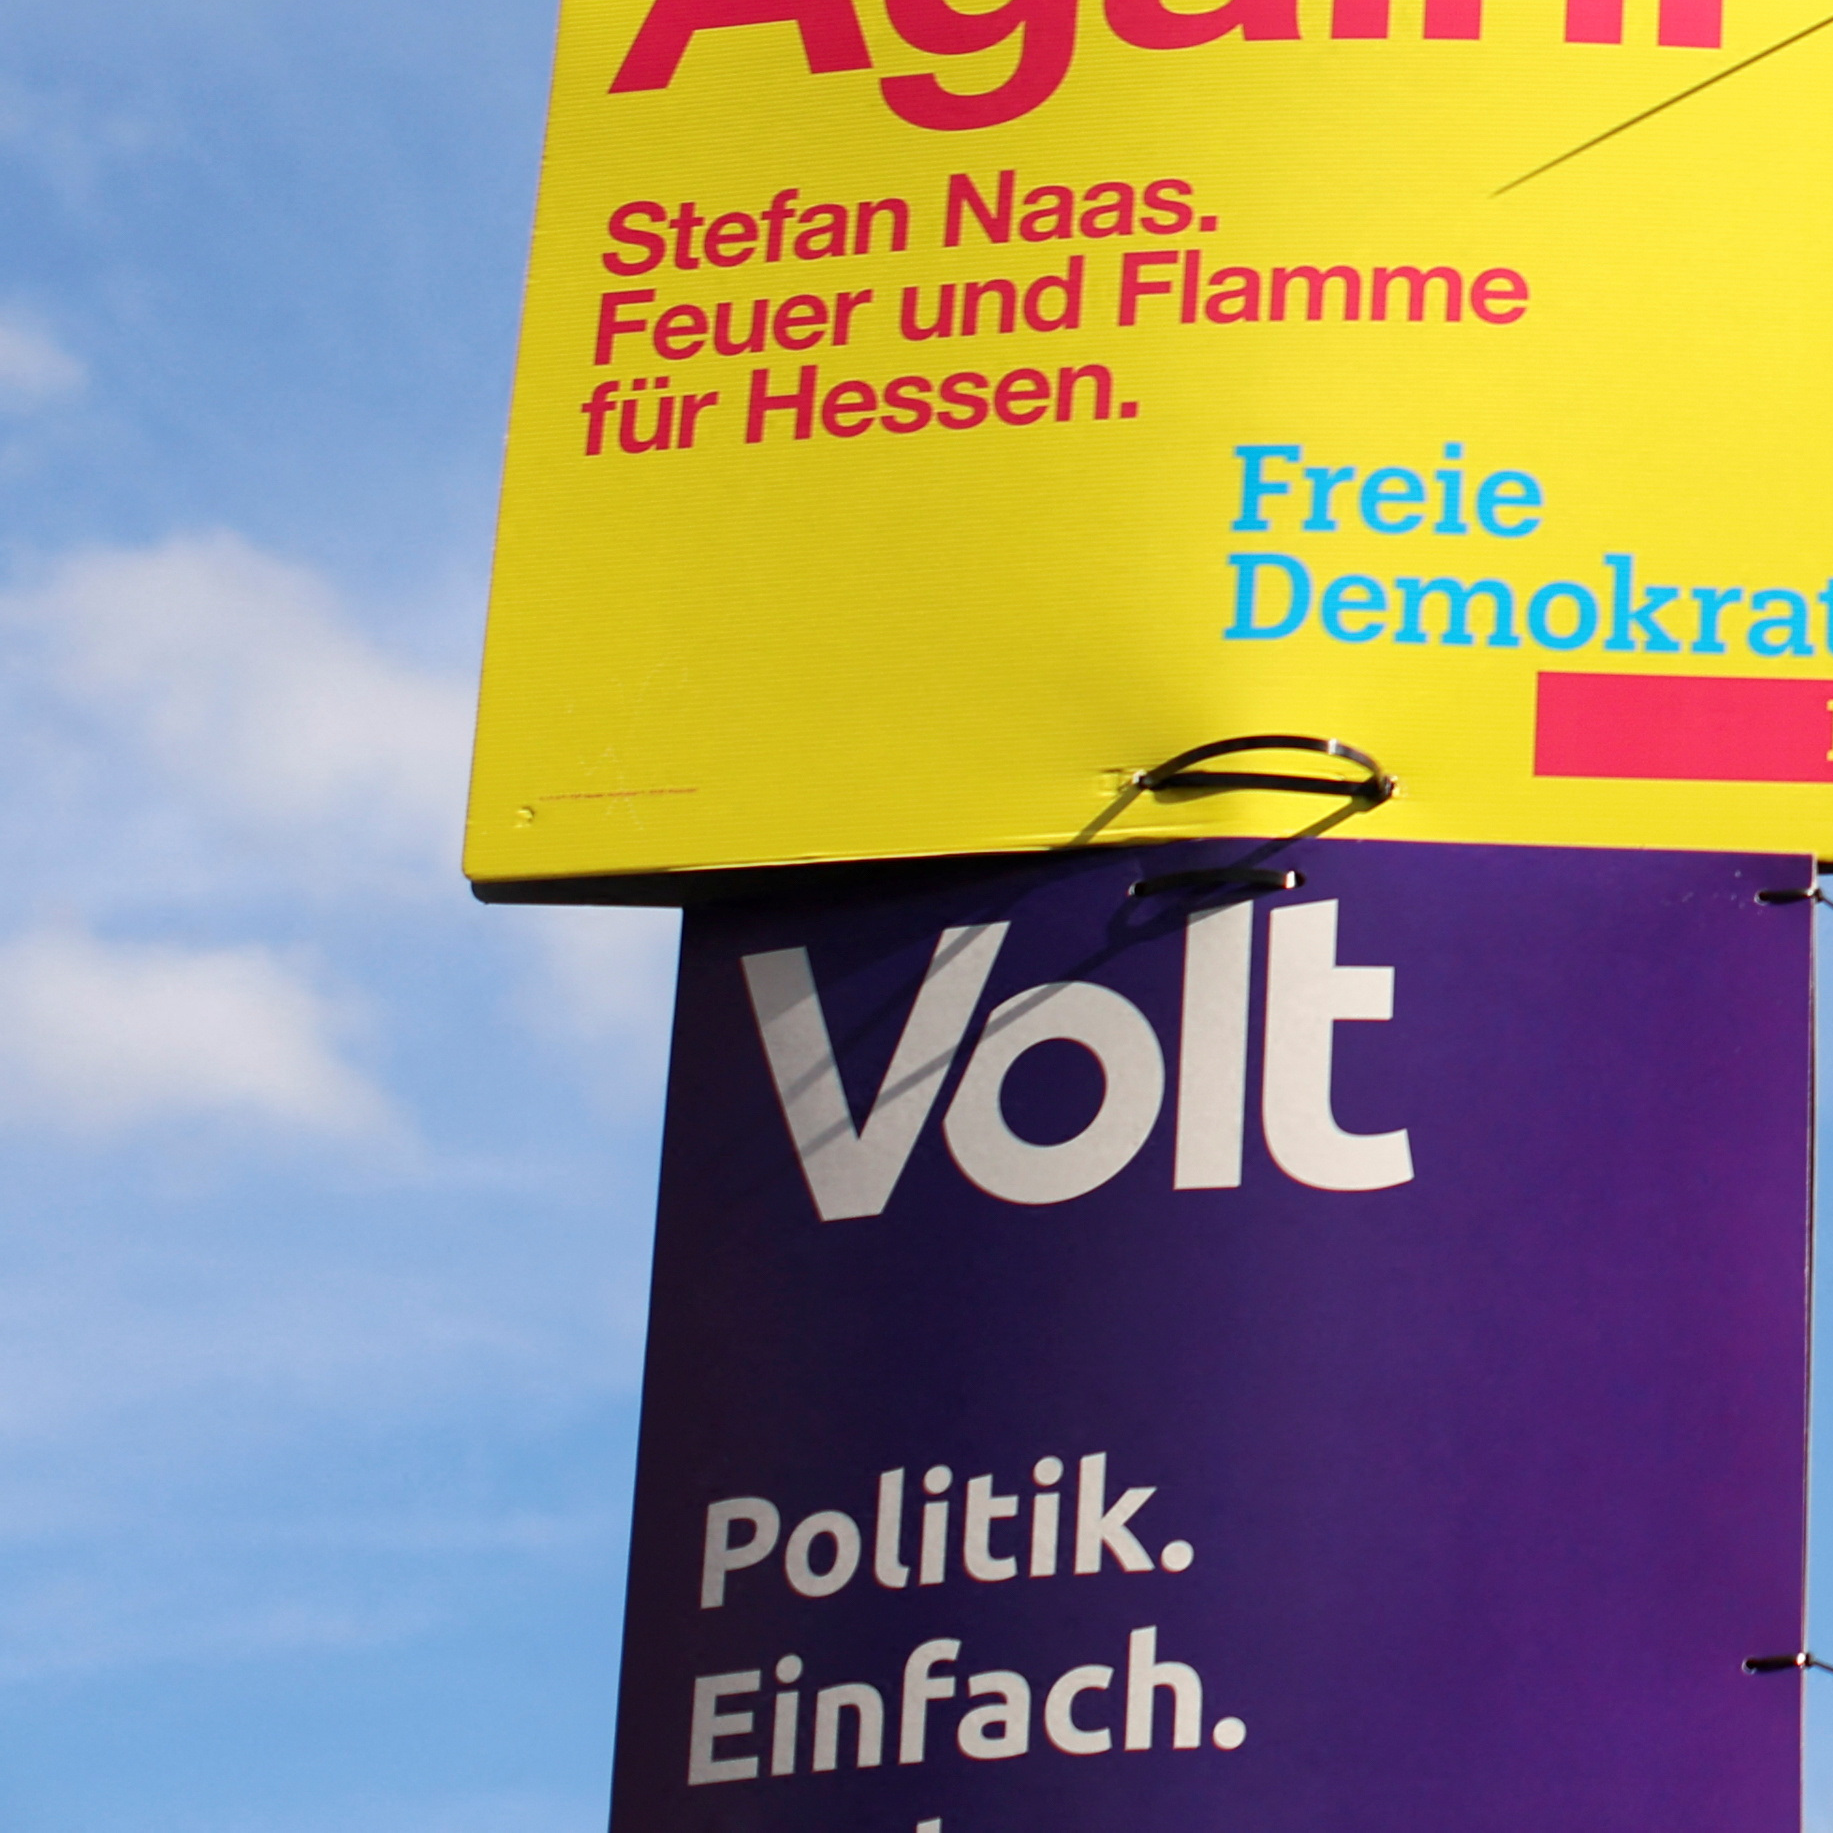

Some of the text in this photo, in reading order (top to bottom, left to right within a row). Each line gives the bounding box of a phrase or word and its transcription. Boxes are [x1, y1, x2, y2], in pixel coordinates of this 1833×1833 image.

[601, 169, 1219, 277] Stefan Naas.
[592, 248, 1531, 367] Feuer und Flamme
[580, 363, 1140, 457] für Hessen.
[1231, 442, 1543, 537] Freie
[741, 897, 1415, 1222] Volt
[700, 1450, 1196, 1610] Politik.
[687, 1624, 1248, 1787] Einfach.
